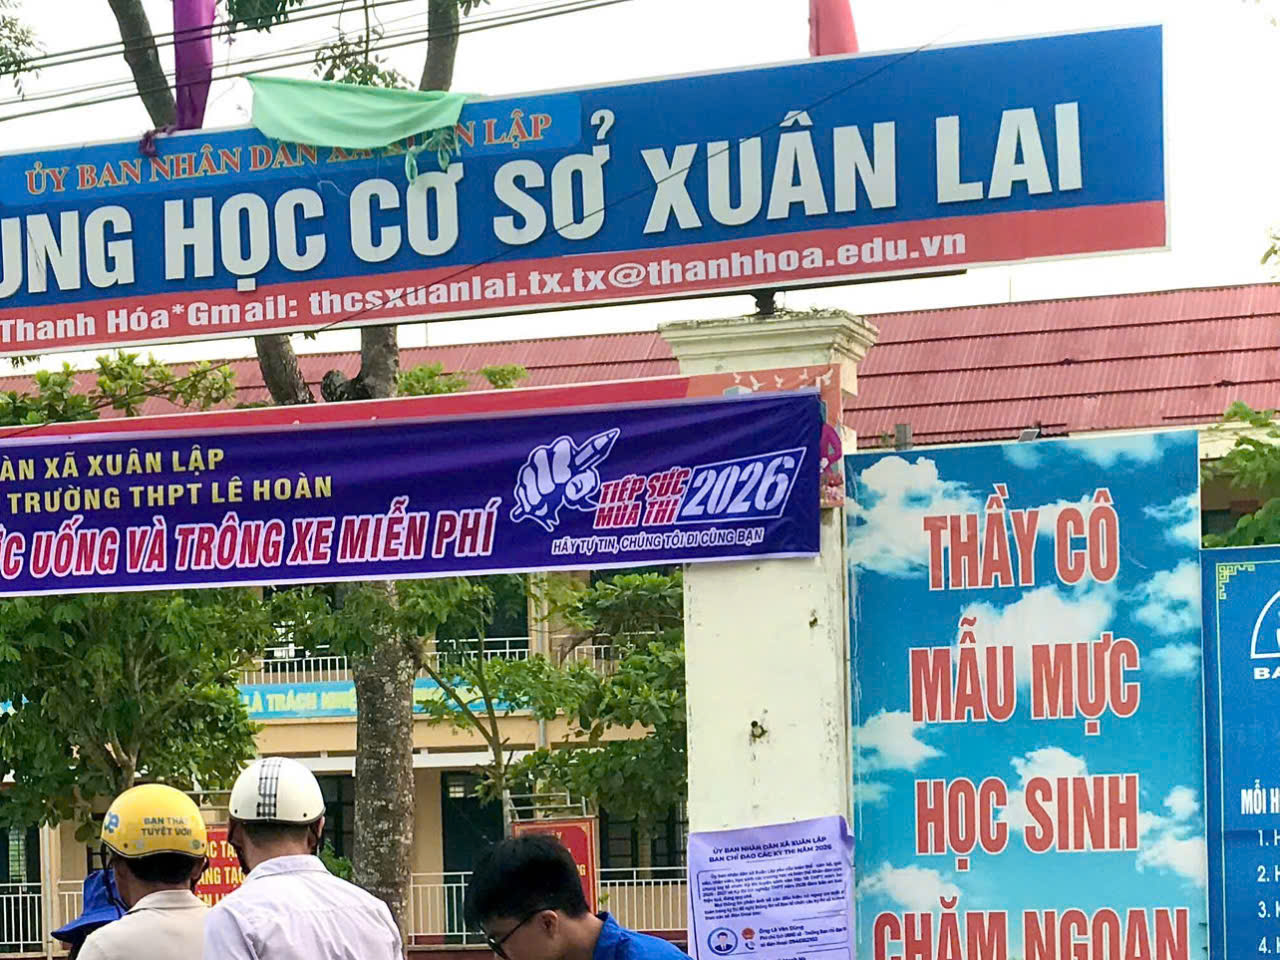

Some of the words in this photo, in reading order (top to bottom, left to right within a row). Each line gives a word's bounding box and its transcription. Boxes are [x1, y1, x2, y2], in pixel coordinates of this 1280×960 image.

[25, 161, 69, 195] ỦY
[77, 158, 142, 190] BAN
[149, 143, 242, 183] NHÂN
[486, 109, 553, 149] LẬP
[164, 187, 327, 292] HỌC
[350, 161, 465, 263] CƠ
[493, 108, 616, 246] SỞ
[640, 110, 896, 234] XUÂN
[935, 101, 1083, 205] LAI
[309, 231, 967, 314] thcsxuanlai.tx.tx@thanhhoa.edu.vn
[44, 451, 78, 479] XÃ
[87, 448, 162, 477] XUÂN
[172, 444, 225, 475] LẬP
[8, 481, 121, 516] TRƯỜNG
[129, 482, 203, 507] THPT
[211, 476, 243, 504] LÊ
[253, 473, 333, 502] HOÀN
[598, 474, 645, 504] TIẾP
[646, 466, 691, 500] SỨC
[680, 455, 796, 517] 2026
[642, 498, 681, 526] THI
[30, 515, 119, 581] UỐNG
[126, 515, 170, 574] VÀ
[174, 508, 283, 572] TRÔNG
[287, 517, 334, 565] XE
[337, 496, 428, 562] MIỄN
[433, 496, 502, 560] PHÍ
[552, 535, 578, 555] HÃY
[579, 536, 597, 556] TỰ
[597, 536, 619, 554] TIN,
[621, 532, 662, 551] CHÚNG
[663, 530, 685, 548] TÔI
[686, 531, 698, 547] ĐI
[698, 528, 735, 546] CÙNG
[736, 527, 764, 547] BẠN
[923, 483, 1040, 591] THẦY
[1055, 488, 1120, 586] CÔ
[909, 615, 1017, 725] MẪU
[1029, 631, 1141, 736] MỰC
[1240, 778, 1267, 815] MỖI
[914, 776, 1009, 872] HỌC
[1023, 773, 1139, 853] SINH
[1258, 830, 1270, 847] 1.
[1257, 865, 1270, 882] 2.
[1258, 901, 1271, 918] 3.
[1258, 936, 1272, 954] 4.
